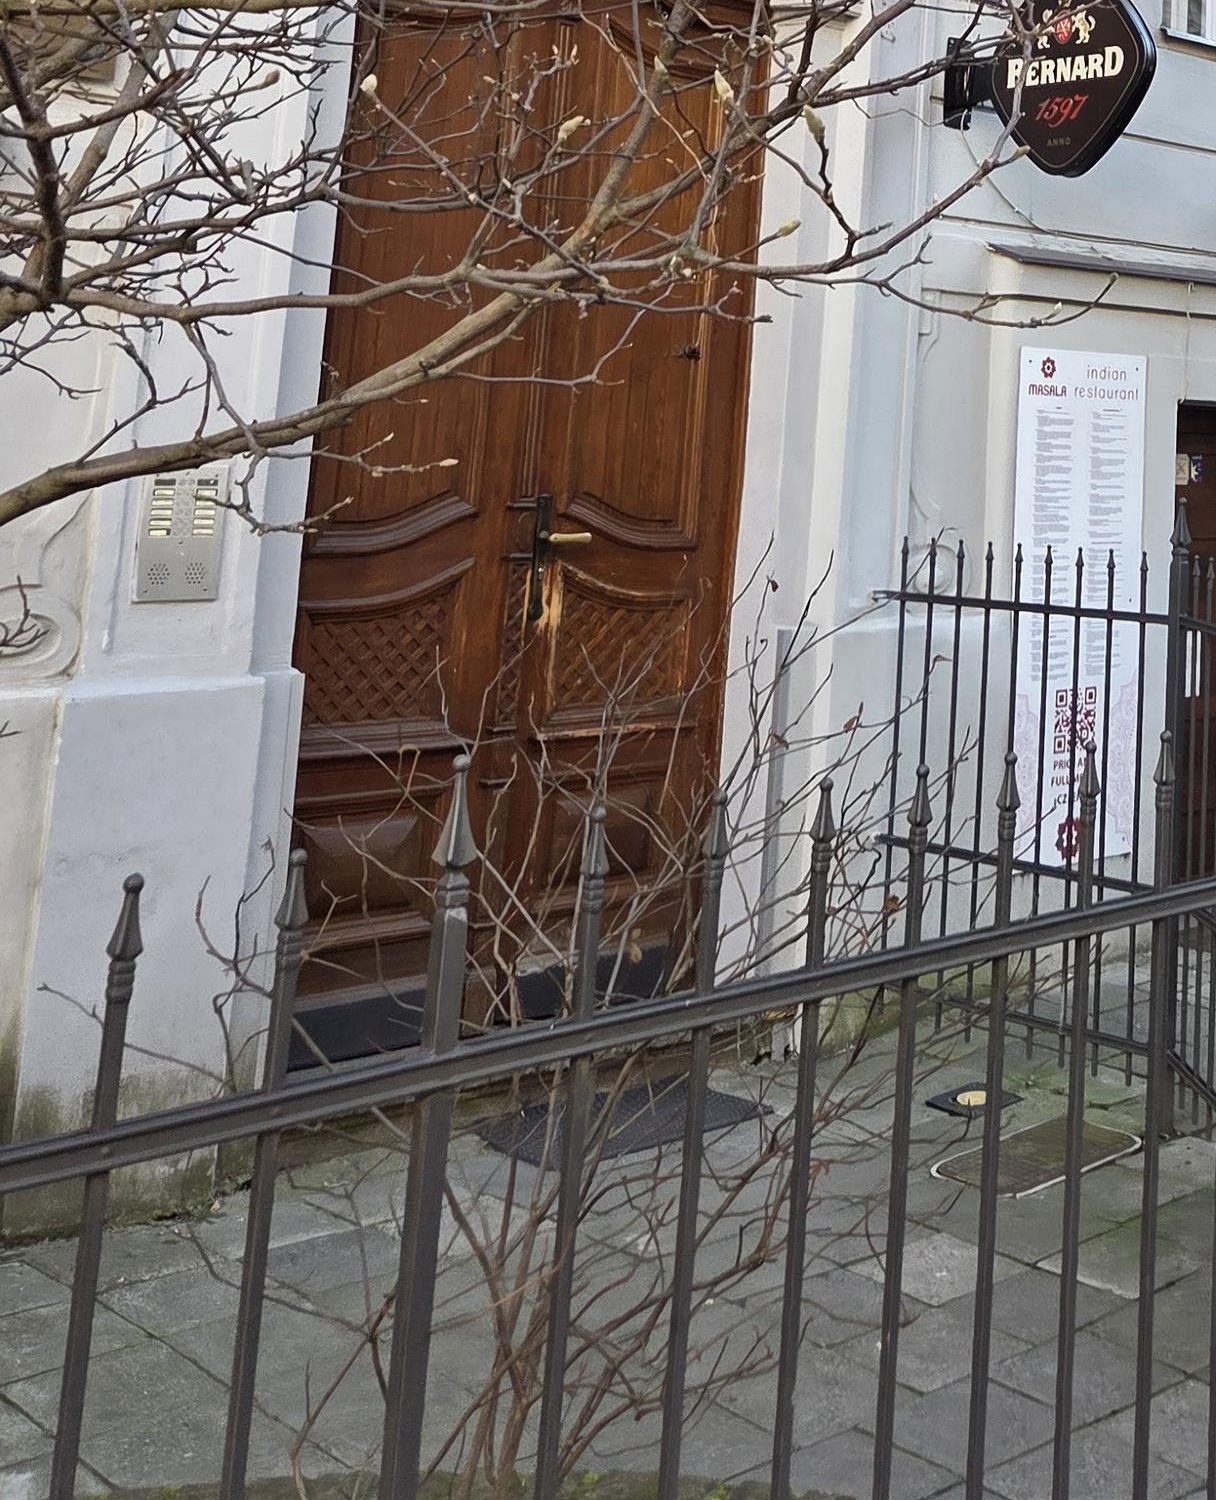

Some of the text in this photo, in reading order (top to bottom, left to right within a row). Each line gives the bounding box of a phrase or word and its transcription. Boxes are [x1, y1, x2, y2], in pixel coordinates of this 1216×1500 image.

[1006, 45, 1125, 89] BERNARD
[1035, 94, 1089, 128] 1597
[1047, 136, 1072, 148] ANNO
[1086, 364, 1127, 381] indian
[1028, 383, 1139, 401] MASALA restaurant
